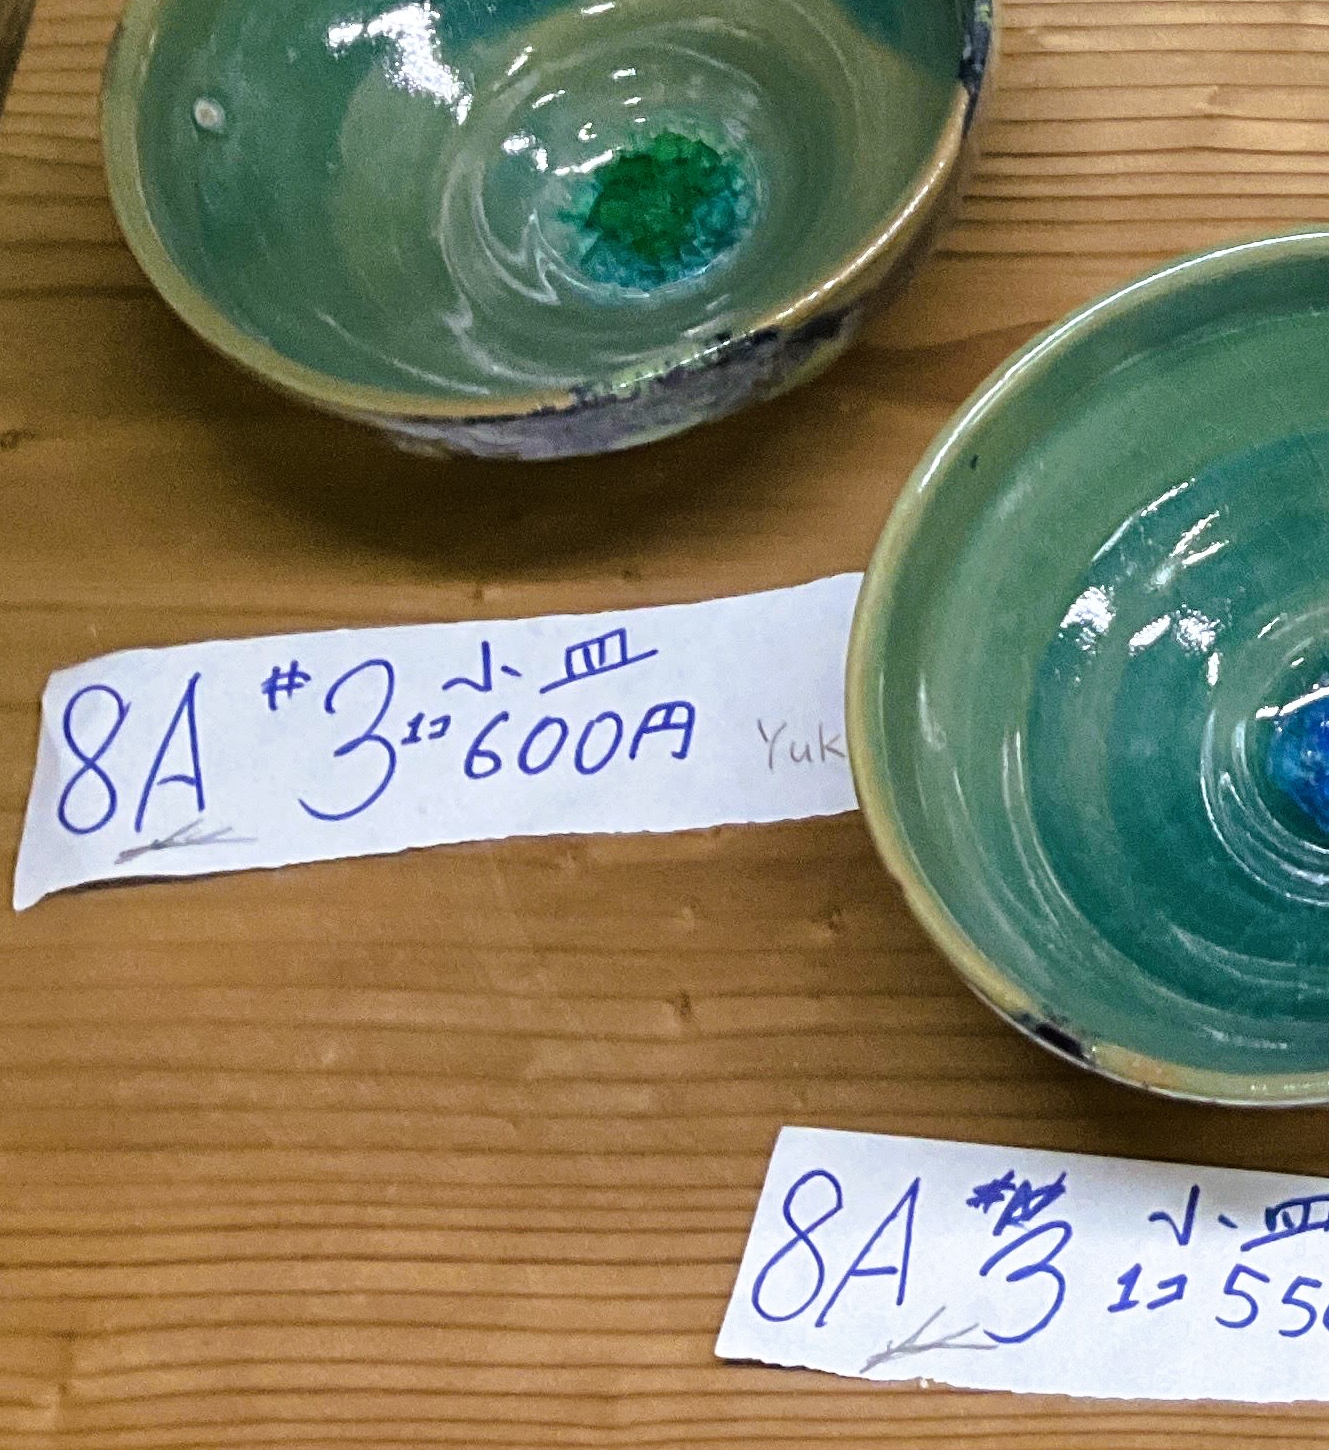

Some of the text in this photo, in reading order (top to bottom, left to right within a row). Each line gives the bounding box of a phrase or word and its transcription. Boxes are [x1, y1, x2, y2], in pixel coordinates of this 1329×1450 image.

[58, 673, 204, 835] 8A
[443, 628, 660, 694] 小皿
[465, 699, 697, 779] 600円
[750, 1169, 922, 1328] 8A
